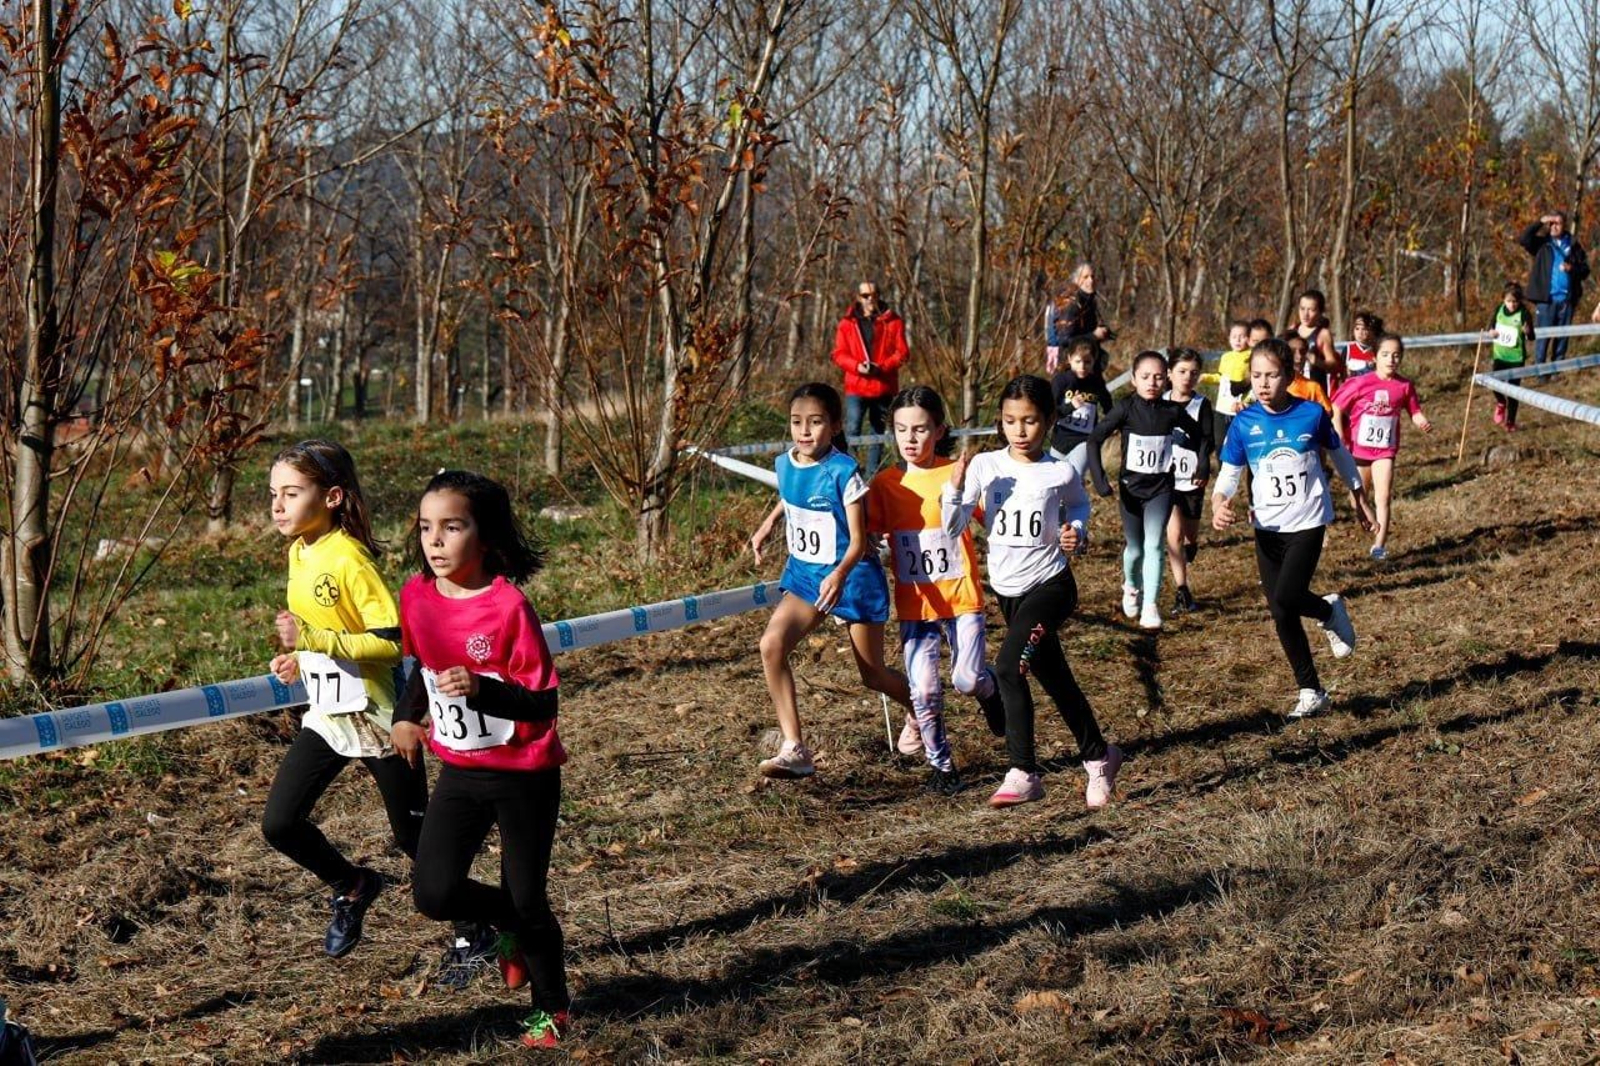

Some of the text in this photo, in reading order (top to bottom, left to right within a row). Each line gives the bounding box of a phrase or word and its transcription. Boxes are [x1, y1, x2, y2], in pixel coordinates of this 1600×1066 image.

[1270, 471, 1308, 498] 357
[996, 508, 1042, 538] 316
[790, 523, 820, 556] 39
[906, 548, 949, 576] 263
[301, 669, 340, 704] 77
[435, 701, 492, 740] 331
